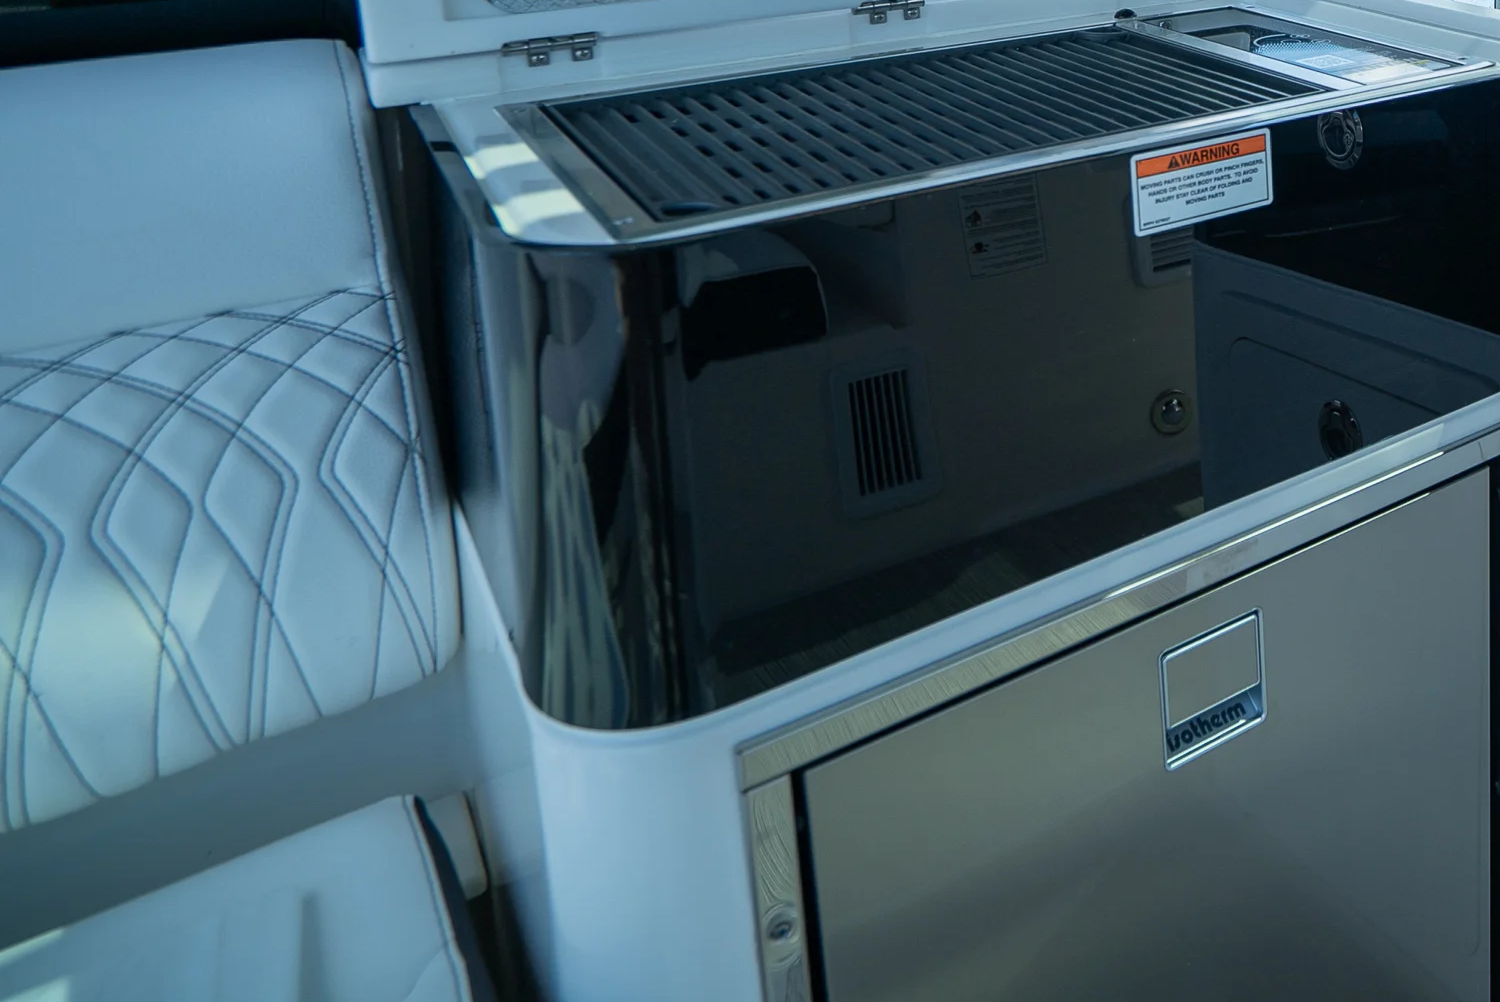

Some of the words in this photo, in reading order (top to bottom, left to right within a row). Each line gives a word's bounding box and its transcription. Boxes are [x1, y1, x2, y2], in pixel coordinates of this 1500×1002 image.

[1180, 143, 1240, 166] WARNING
[1141, 181, 1163, 190] MOVING
[1164, 177, 1181, 185] PARTS
[1196, 170, 1214, 178] CRUSH
[1148, 188, 1168, 197] HANDS
[1178, 182, 1196, 190] OTHER
[1197, 178, 1212, 186] BODY
[1213, 174, 1232, 182] PARTS.
[1243, 167, 1258, 176] AVOID
[1155, 195, 1175, 204] INJURY
[1190, 187, 1208, 196] CLEAR
[1218, 180, 1240, 190] FOLDING
[1185, 196, 1206, 205] MOVING
[1207, 191, 1225, 200] PARTS
[1166, 701, 1247, 753] isotherm
